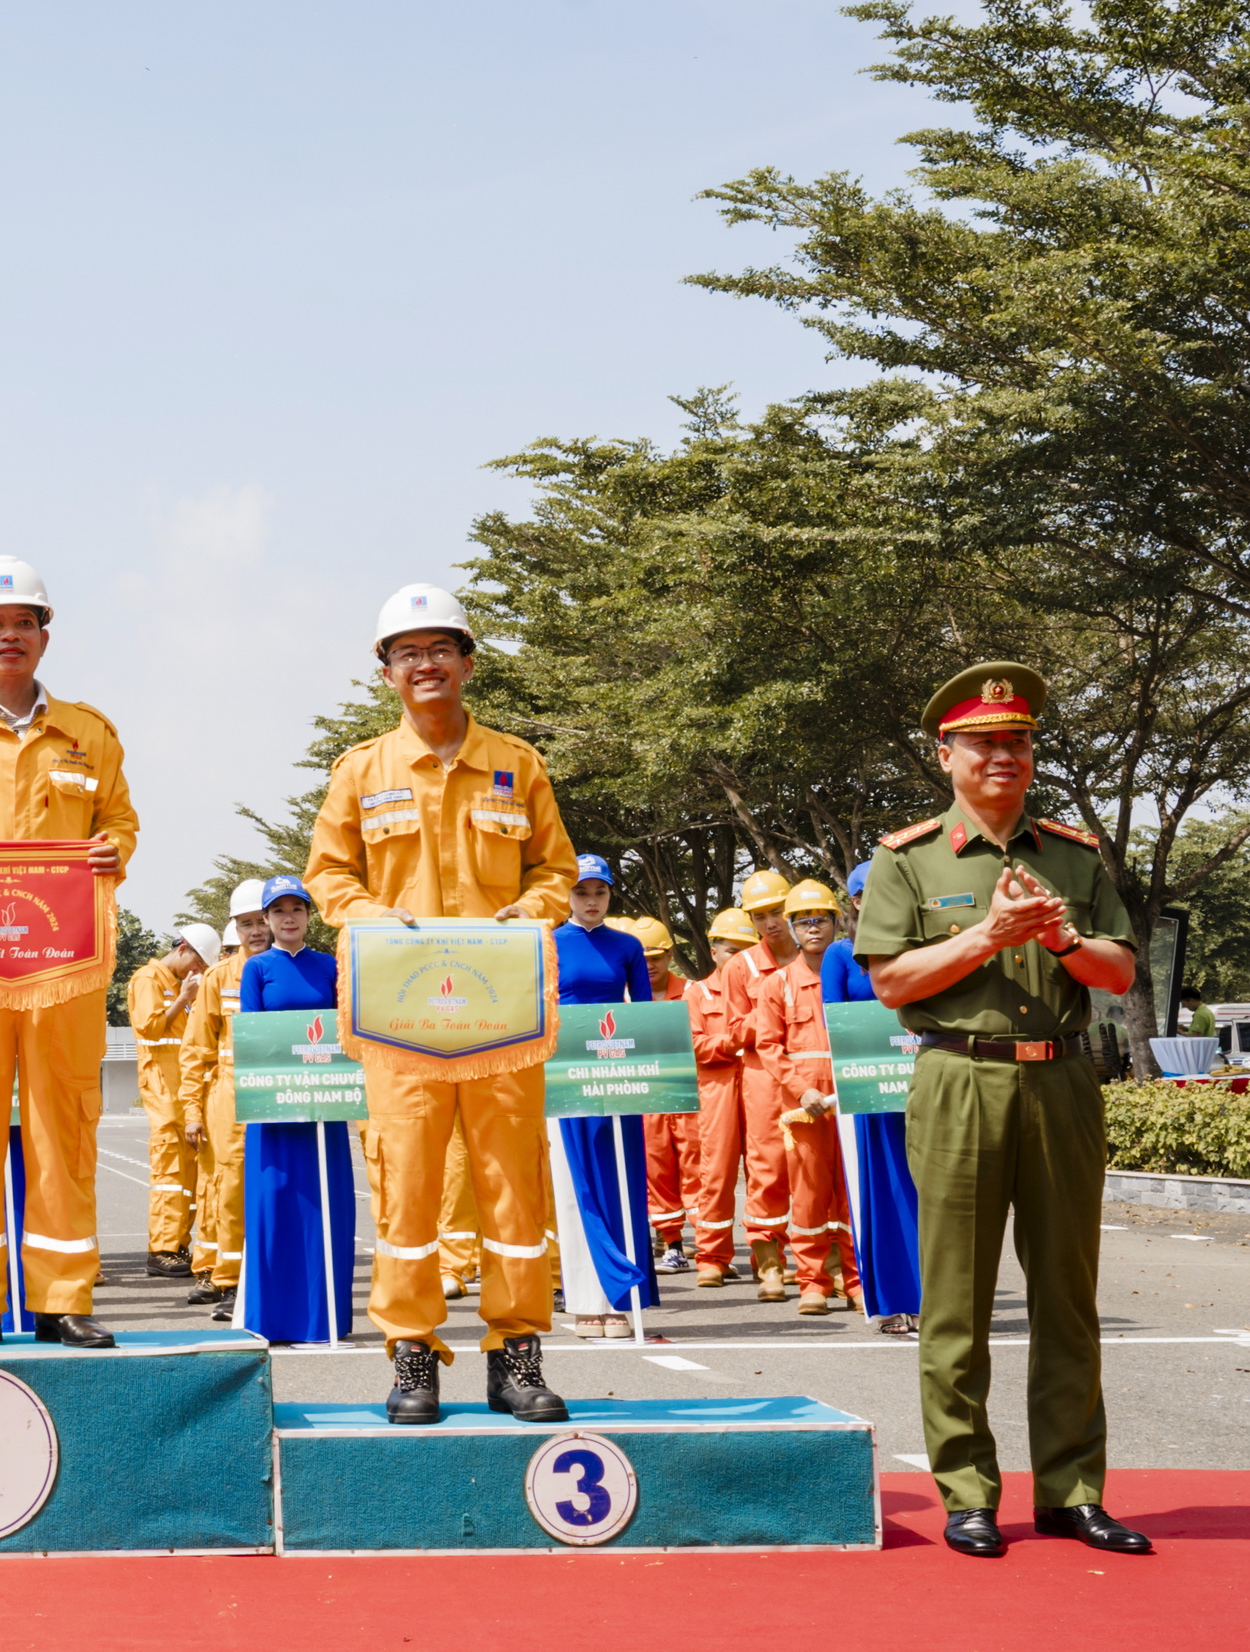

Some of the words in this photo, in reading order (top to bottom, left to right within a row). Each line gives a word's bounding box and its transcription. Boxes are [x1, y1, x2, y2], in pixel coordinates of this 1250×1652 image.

[12, 866, 27, 875] VIỆT
[28, 866, 45, 874] NAM
[51, 866, 69, 874] CTCP
[11, 889, 34, 901] CNCH
[47, 913, 60, 932] 2024
[9, 947, 38, 958] Toàn
[42, 947, 75, 958] Đoàn
[403, 971, 420, 988] THAO
[419, 961, 439, 974] PCCC
[450, 960, 472, 972] CNCH
[486, 986, 499, 1003] 2024
[419, 1018, 436, 1030] Ba
[239, 1073, 273, 1087] CÔNG
[276, 1074, 292, 1086] TY
[293, 1071, 320, 1088] VẬN
[322, 1068, 366, 1085] CHUYỂ
[568, 1067, 589, 1079] CHI
[591, 1062, 636, 1079] NHÁNH
[637, 1060, 660, 1077] KHÍ
[841, 1062, 877, 1078] CÔNG
[878, 1064, 895, 1076] TY
[582, 1081, 605, 1096] HẢI
[606, 1079, 649, 1095] PHÒNG
[878, 1080, 908, 1094] NAM
[276, 1089, 311, 1104] ĐÔNG
[313, 1091, 342, 1103] NAM
[345, 1087, 362, 1105] BỘ
[553, 1449, 612, 1527] 3
